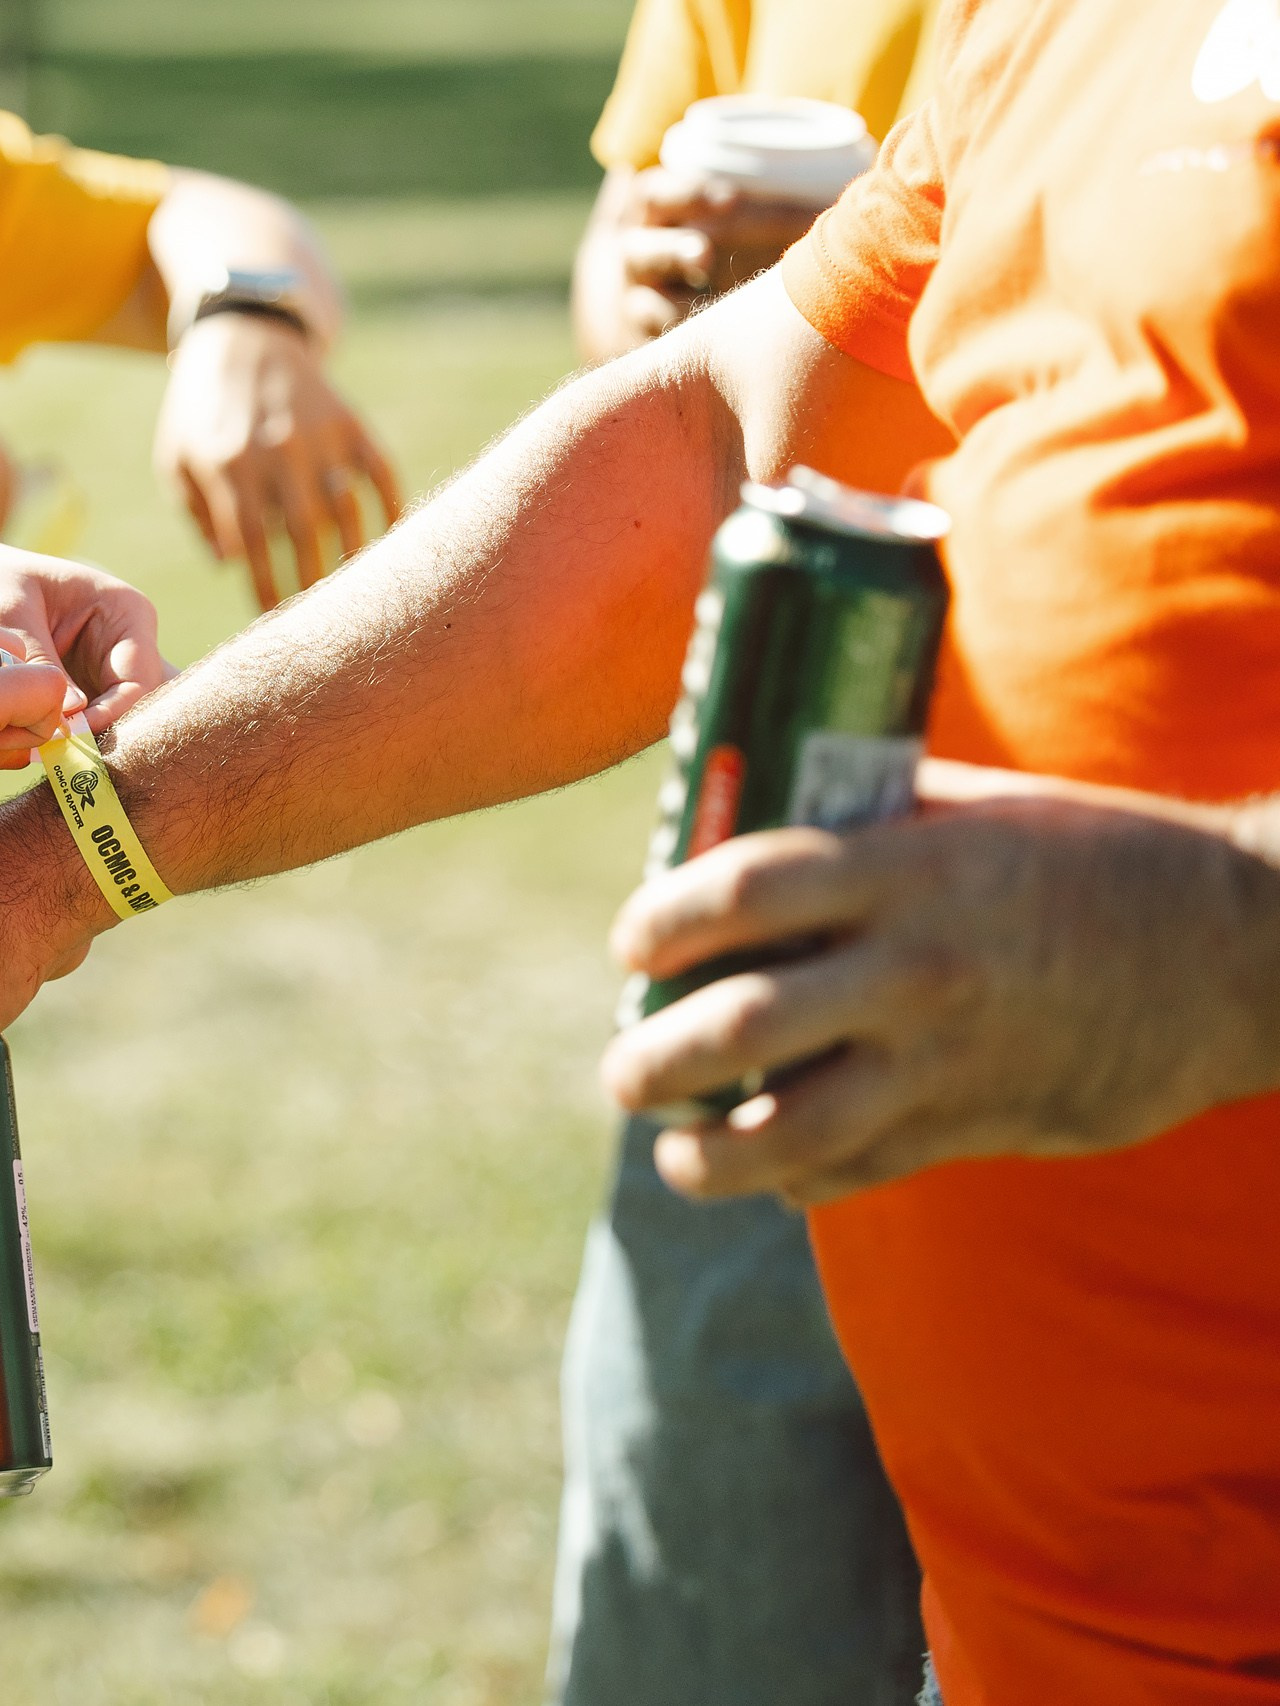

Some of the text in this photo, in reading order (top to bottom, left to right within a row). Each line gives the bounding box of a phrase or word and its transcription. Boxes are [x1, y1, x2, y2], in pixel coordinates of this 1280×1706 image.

[53, 765, 67, 788] OCMC
[65, 793, 84, 829] RAPTOR
[91, 824, 136, 885] OCMC
[121, 884, 140, 898] &
